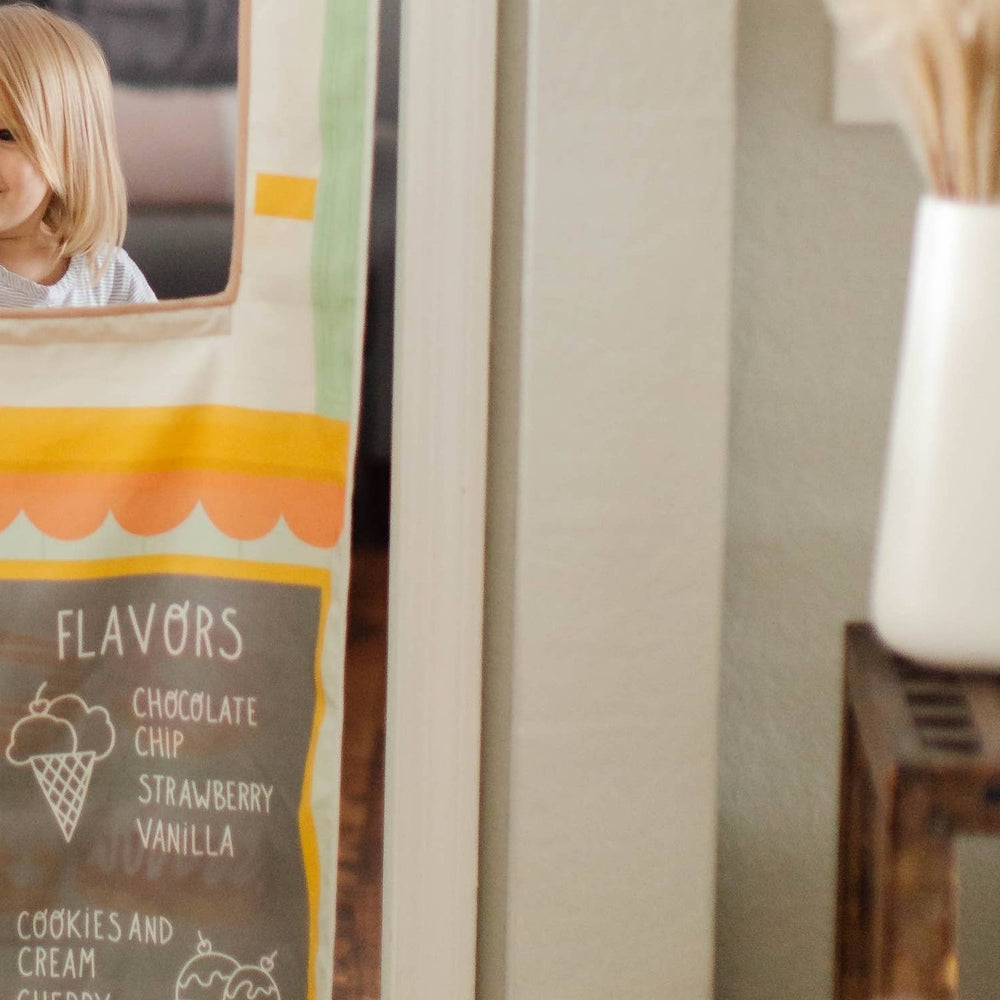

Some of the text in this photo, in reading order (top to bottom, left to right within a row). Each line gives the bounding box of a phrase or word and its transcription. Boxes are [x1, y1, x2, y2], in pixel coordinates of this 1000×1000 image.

[133, 687, 257, 727] CHOCOLATE
[134, 726, 184, 759] CHIP
[138, 774, 274, 814] STRAWBERRY
[136, 817, 234, 858] VANILLA
[17, 907, 173, 945] COOKIES AND
[17, 946, 96, 979] CREAM
